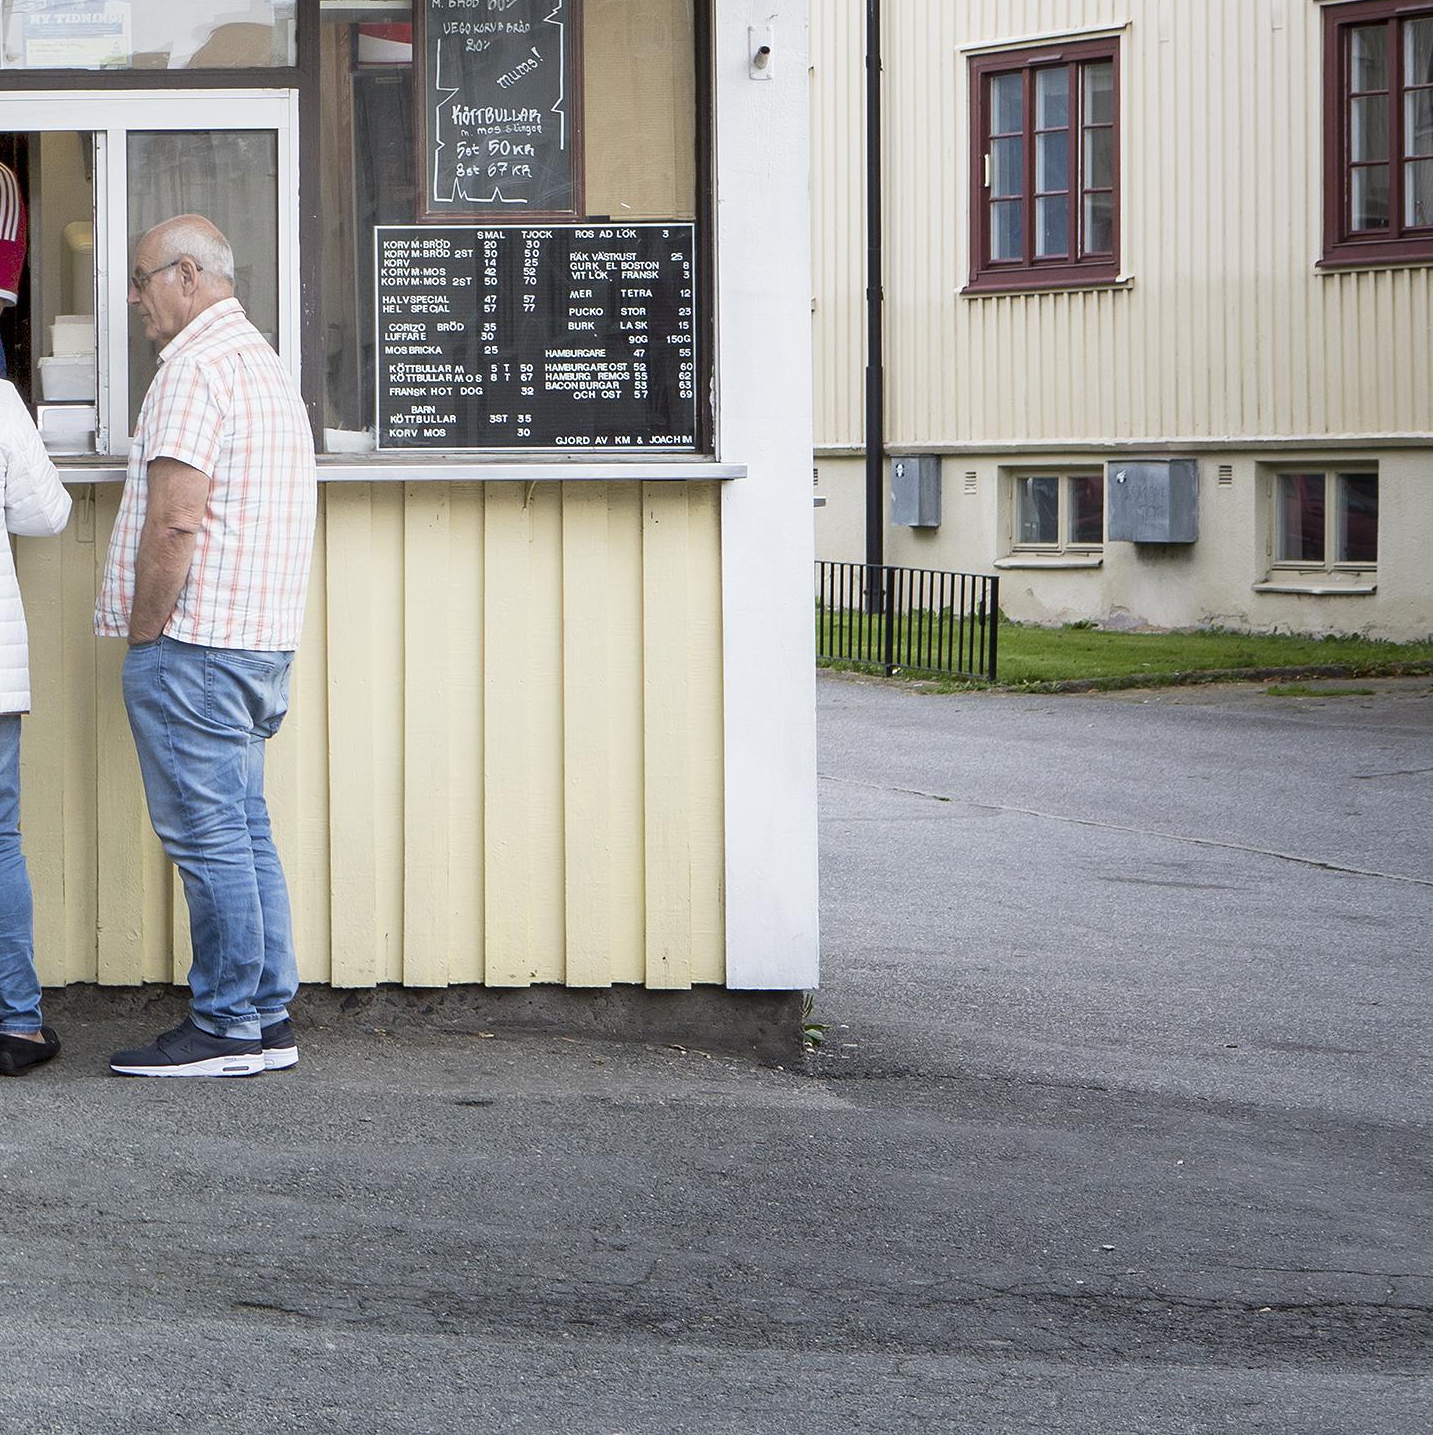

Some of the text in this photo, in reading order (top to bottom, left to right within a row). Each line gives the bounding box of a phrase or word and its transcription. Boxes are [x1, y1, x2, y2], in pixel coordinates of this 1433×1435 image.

[477, 231, 553, 239] SMAL TJOCK
[575, 229, 669, 238] ROS AD LÖK 3
[384, 250, 409, 258] KORV
[455, 250, 473, 258] 2ST
[570, 252, 589, 261] RÄK
[592, 252, 637, 261] VÄSTKUST
[384, 259, 410, 267] KORV
[570, 262, 599, 270] GURK
[621, 261, 659, 269] BOSTON
[622, 271, 659, 279] FRANSK
[453, 278, 472, 286] 2ST
[570, 290, 592, 298] MER
[524, 295, 535, 303] 57
[383, 305, 402, 313] HEL
[411, 305, 450, 313] SPECIAL
[484, 305, 496, 313] 57
[569, 308, 603, 316] PUCKO
[389, 324, 426, 332] CORIZO
[437, 321, 464, 331] BRÖD
[568, 322, 594, 330] BURK
[385, 333, 426, 341] LUFFARE
[667, 335, 691, 343] 150G
[389, 364, 451, 373] KÖTTBULLAR
[455, 365, 464, 373] M
[390, 373, 452, 382] KÖTTBULLAR
[454, 374, 482, 382] MOS
[521, 374, 533, 382] 67
[389, 388, 426, 396] FRANSK
[460, 387, 483, 395] DOG
[411, 406, 435, 414] BARN
[390, 414, 532, 423] KÖTTBULLAR 3ST 35
[389, 429, 418, 437] KORV
[424, 429, 446, 437] MOS
[556, 437, 590, 445] GJORD
[615, 436, 630, 444] KM
[649, 435, 692, 443] JOACHIM
